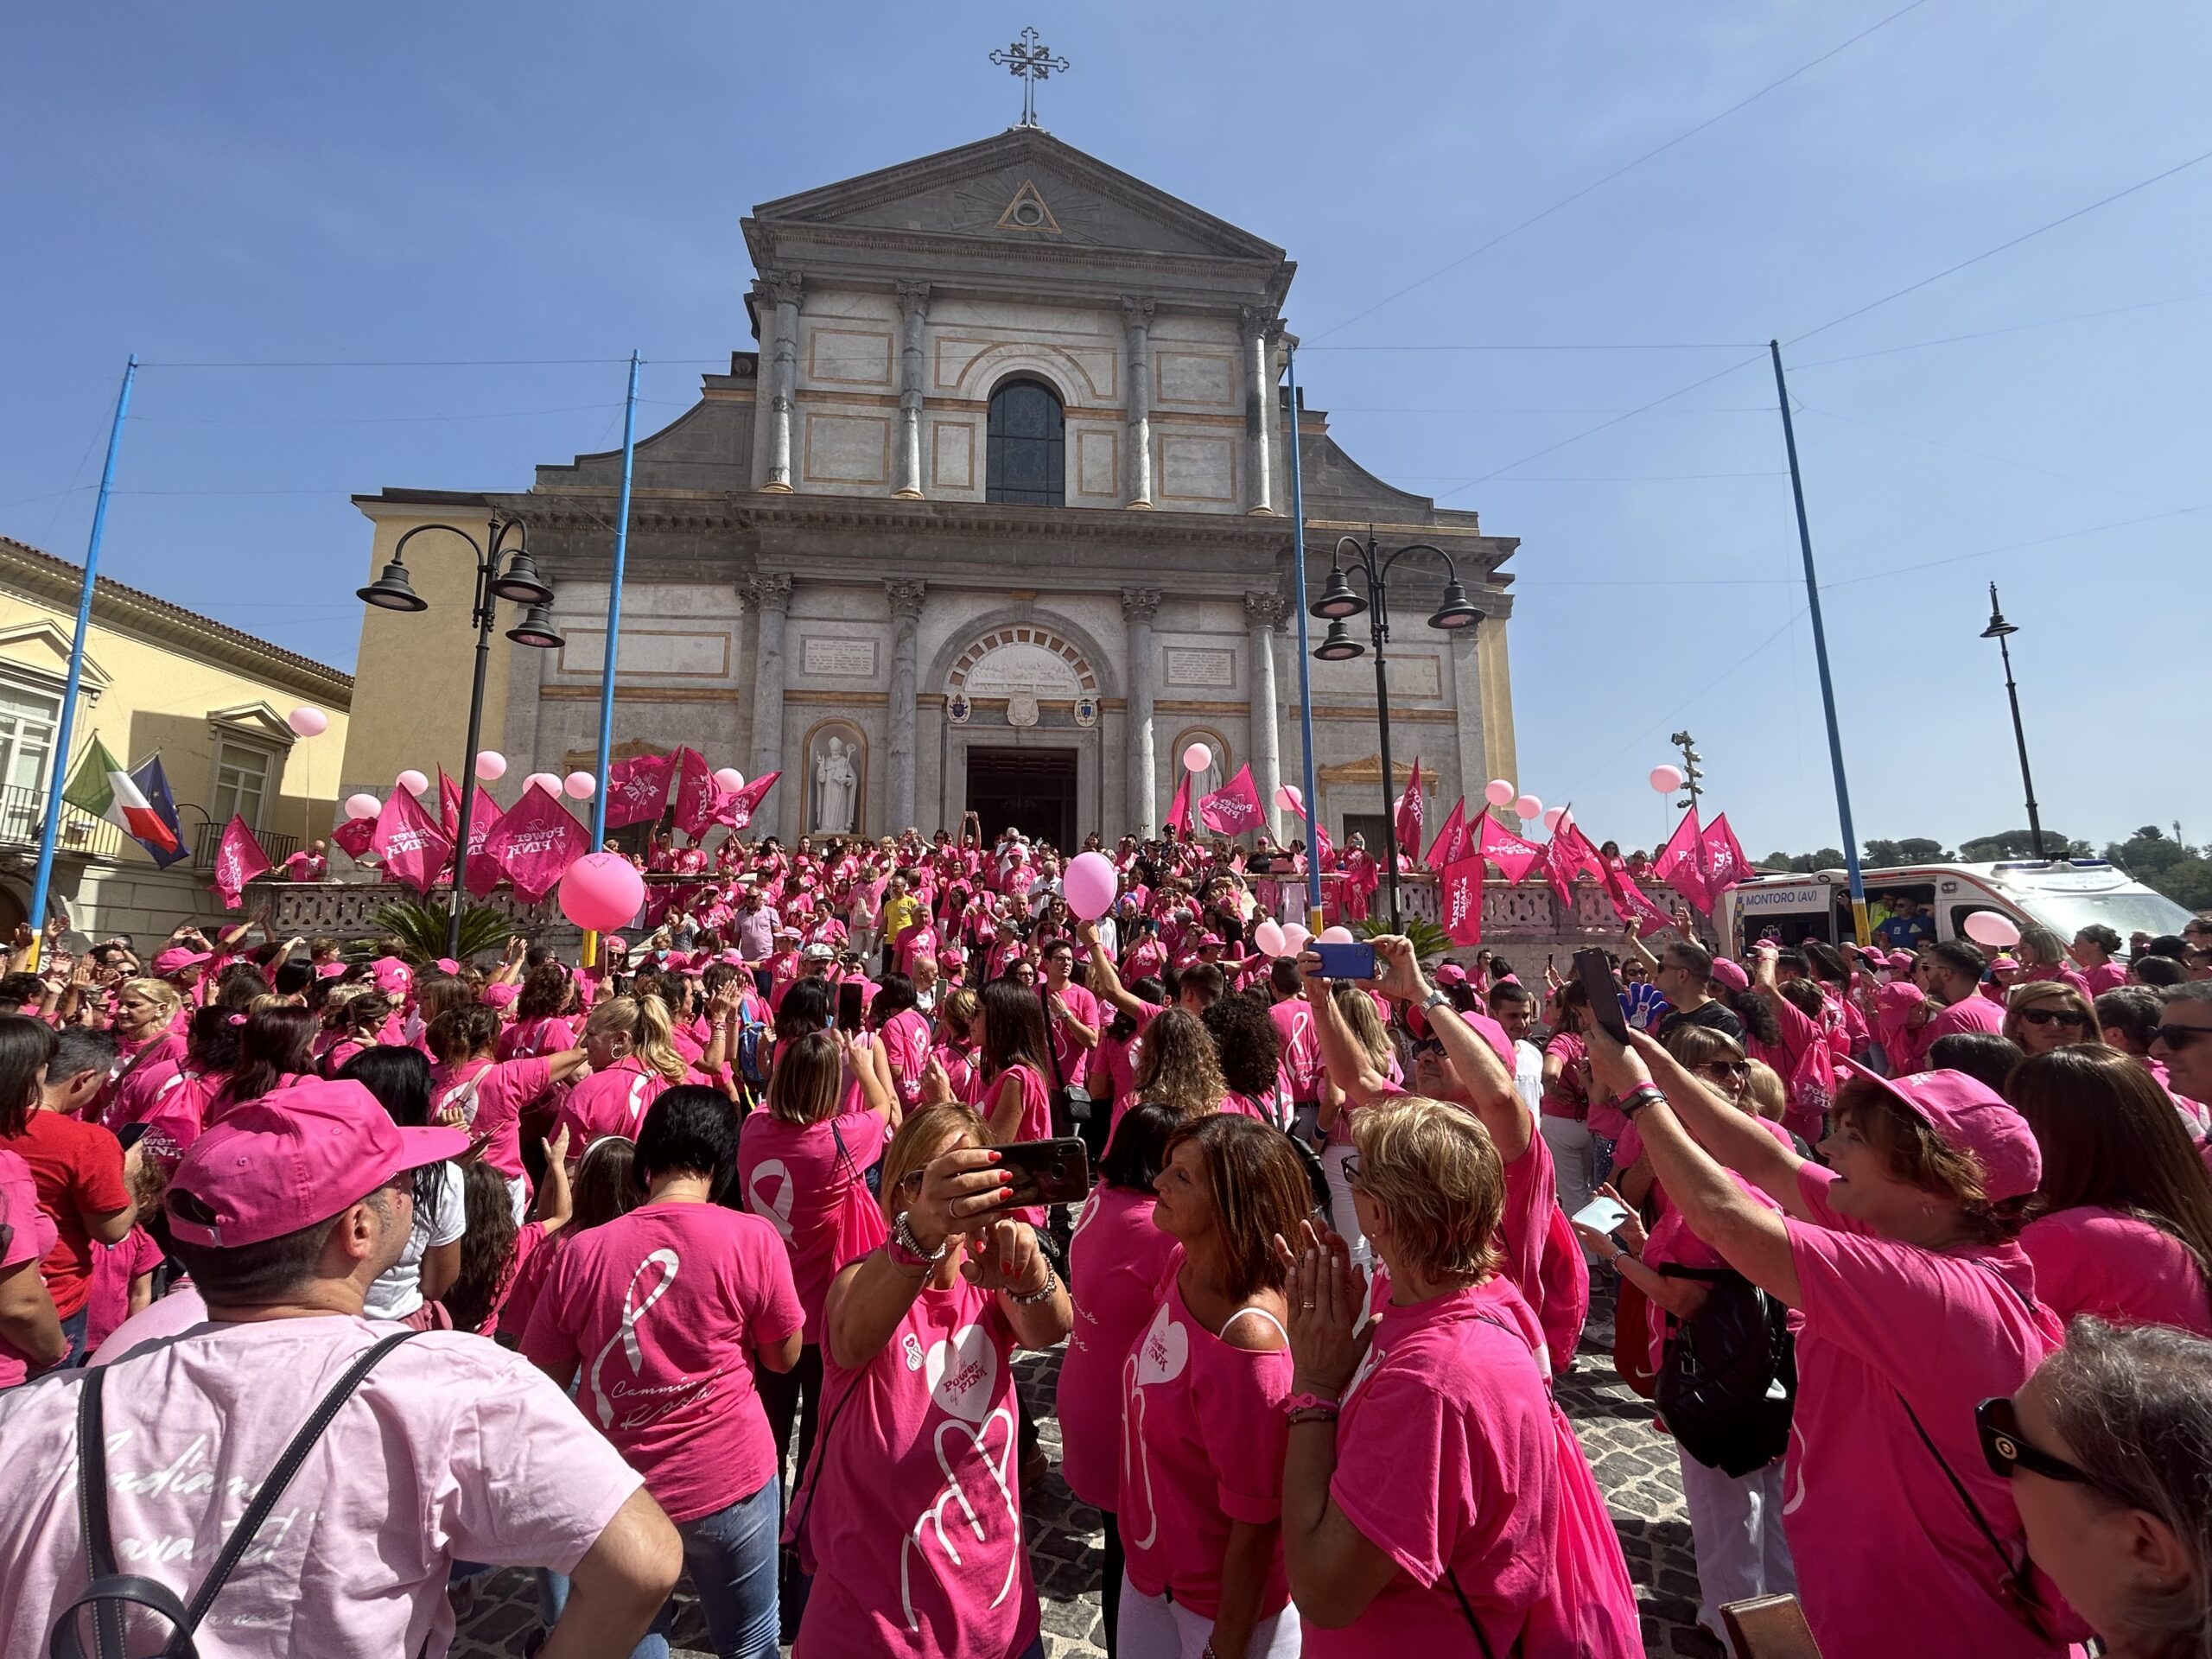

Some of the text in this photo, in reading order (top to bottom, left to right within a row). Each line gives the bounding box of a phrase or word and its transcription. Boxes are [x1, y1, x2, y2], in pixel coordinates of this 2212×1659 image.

[1449, 889, 1460, 931] PINK
[1459, 875, 1467, 919] Power
[1745, 890, 1817, 906] MONTORO (AV)
[943, 1359, 978, 1393] Power
[958, 1366, 988, 1395] PINK
